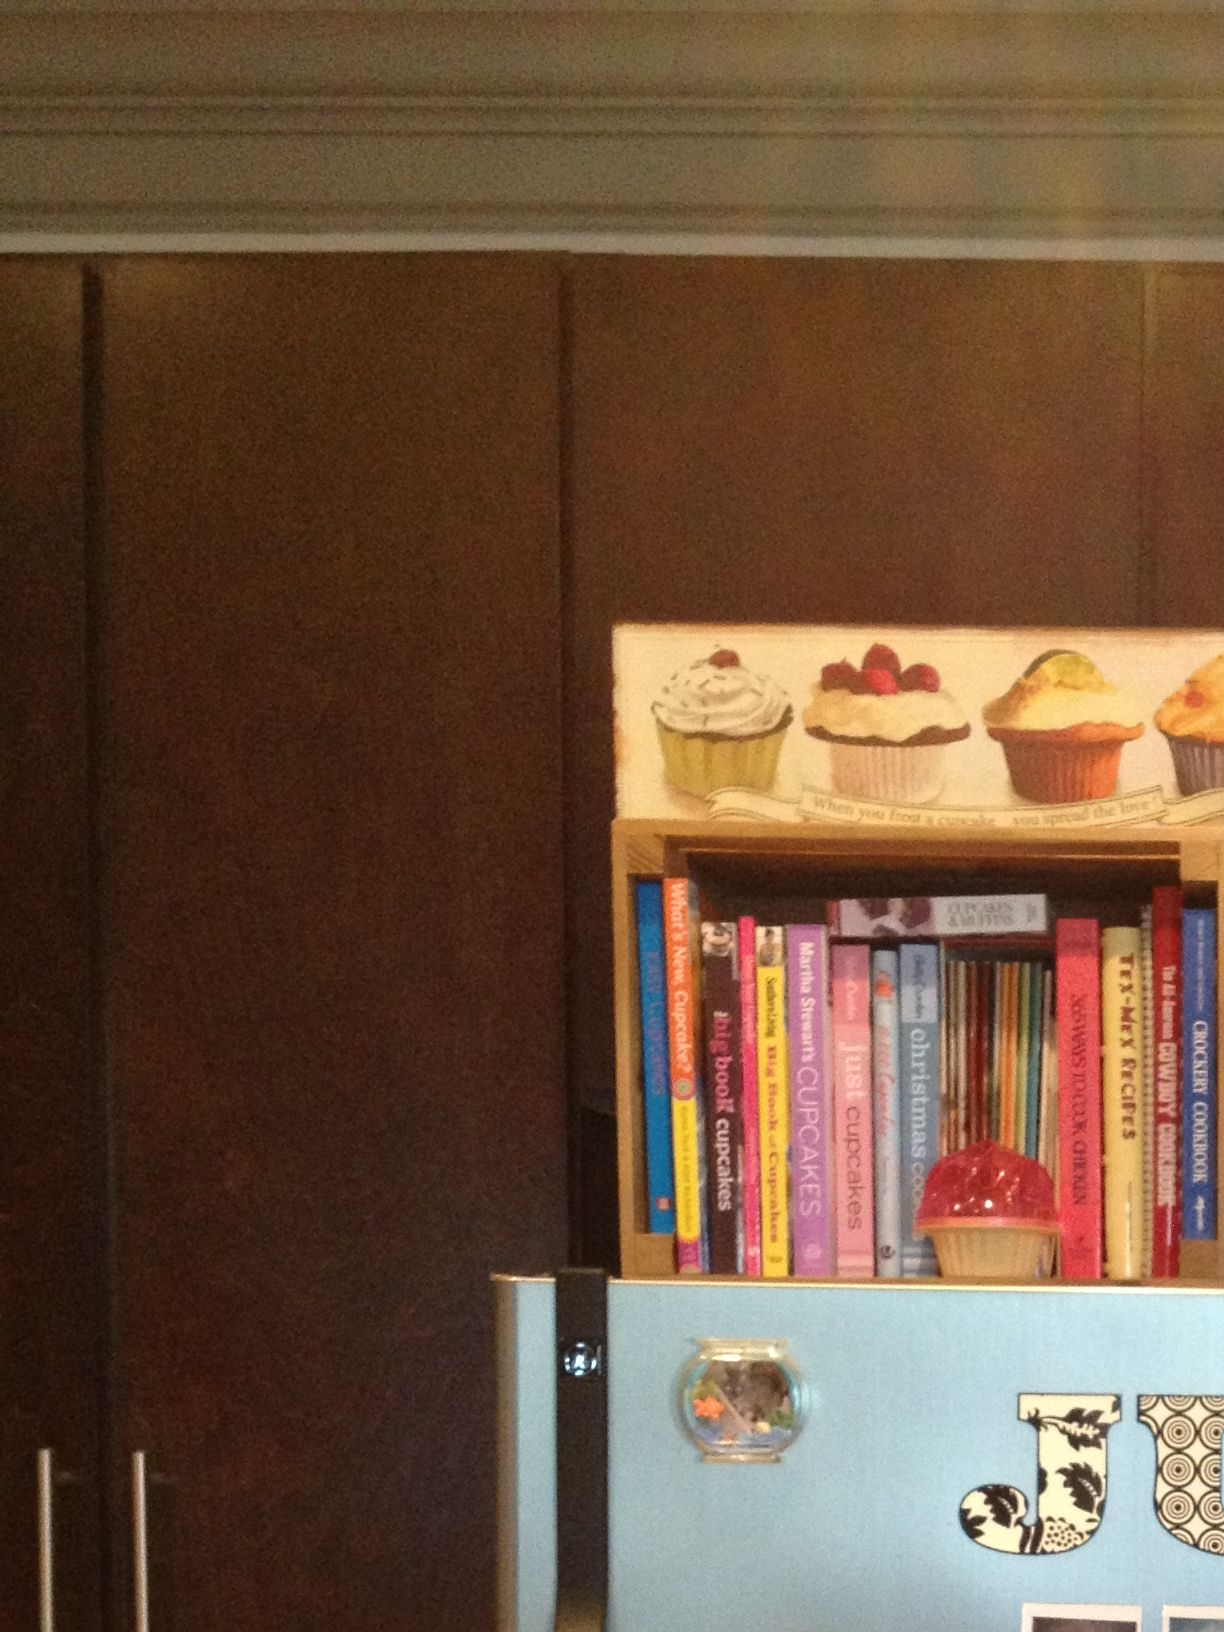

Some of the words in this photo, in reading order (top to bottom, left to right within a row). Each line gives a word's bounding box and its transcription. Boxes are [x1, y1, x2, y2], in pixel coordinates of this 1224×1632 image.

[1043, 807, 1090, 827] spread
[1094, 804, 1117, 818] the
[669, 881, 688, 940] What's
[672, 946, 689, 985] New,
[799, 941, 816, 994] Martha
[671, 990, 693, 1073] Cupcake?
[709, 1018, 731, 1056] big
[800, 997, 817, 1063] Stewart's
[1192, 1020, 1209, 1095] CROCKERY
[839, 1044, 868, 1101] just
[910, 1027, 931, 1158] christmas
[1158, 1042, 1178, 1118] COWBOY
[714, 1118, 735, 1211] cupcakes
[796, 1066, 822, 1217] CUPCAKES
[843, 1106, 867, 1230] cupcakes
[1157, 1123, 1177, 1207] COOKBOOK
[1192, 1101, 1209, 1185] COOKBOOK
[766, 1152, 780, 1244] Cupcakes
